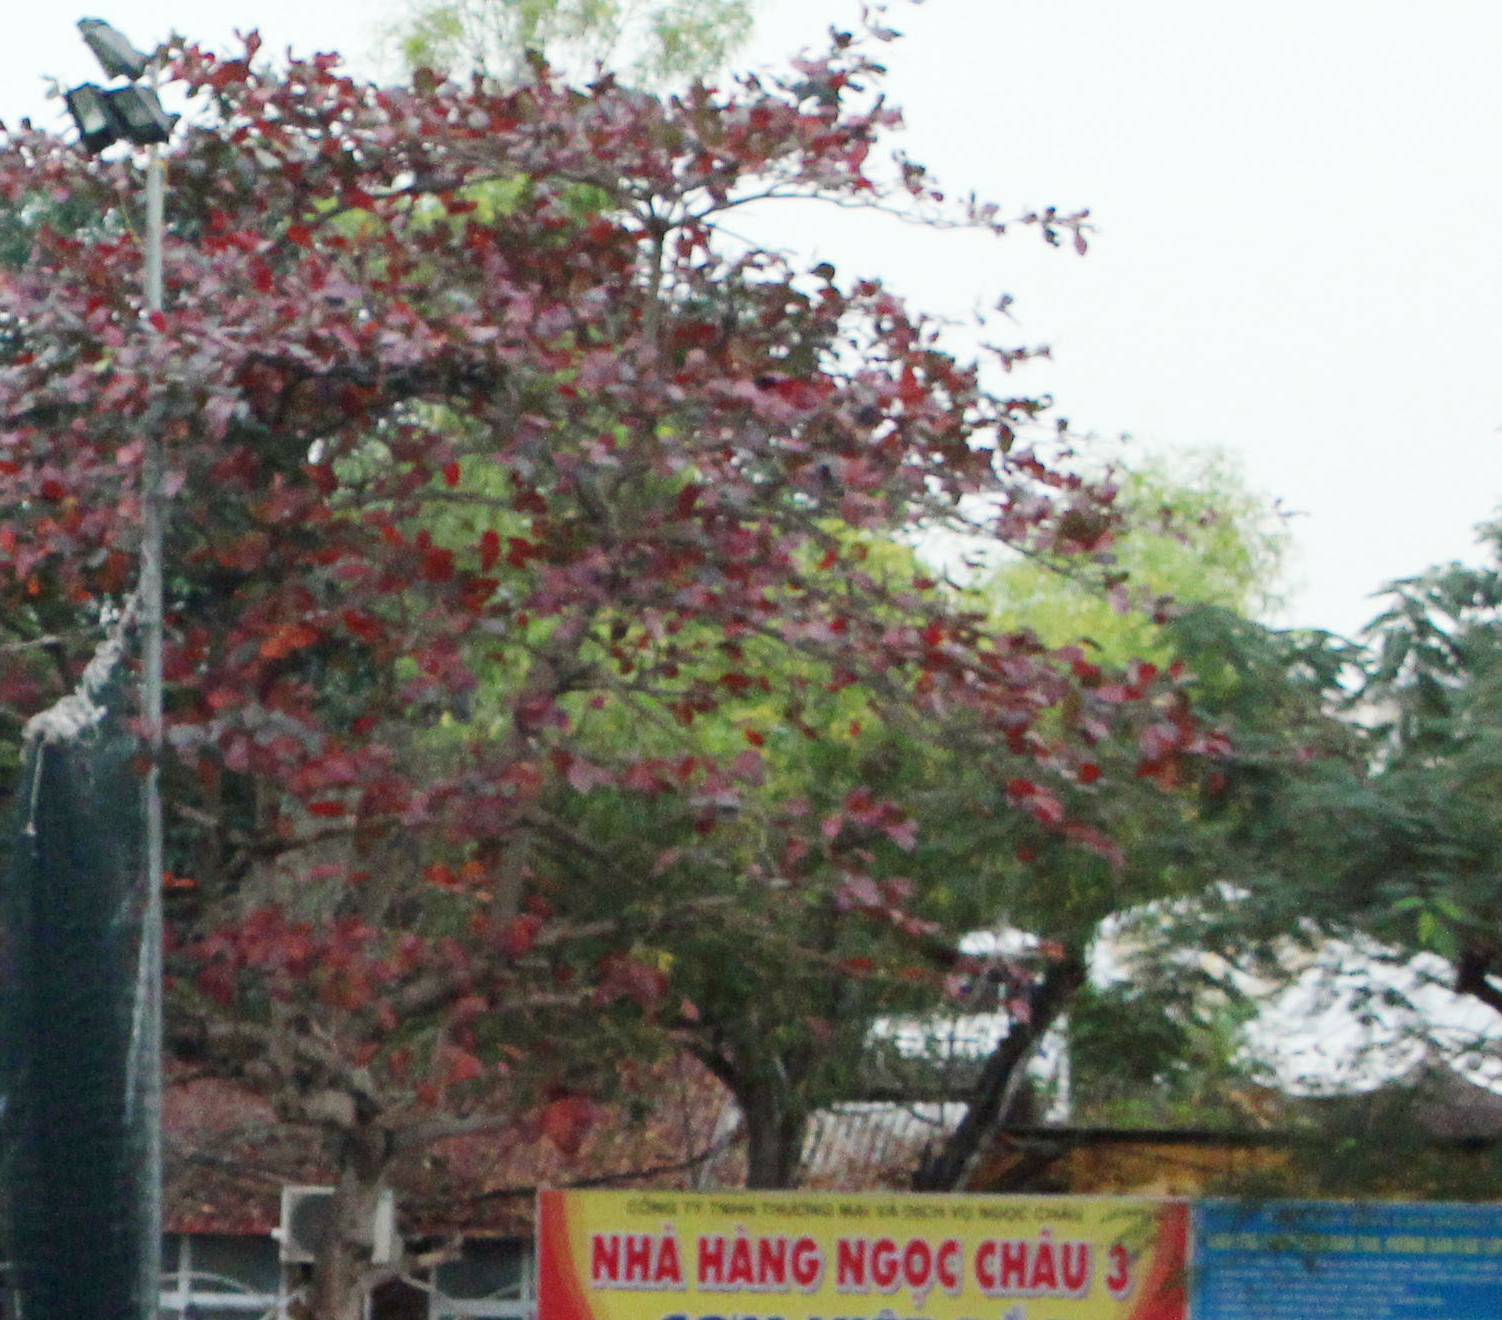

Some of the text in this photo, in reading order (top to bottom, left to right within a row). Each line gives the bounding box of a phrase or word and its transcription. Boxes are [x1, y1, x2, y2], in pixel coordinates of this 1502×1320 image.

[591, 1222, 1131, 1309] NHÀ HÀNG NGỌC CHÂU 3
